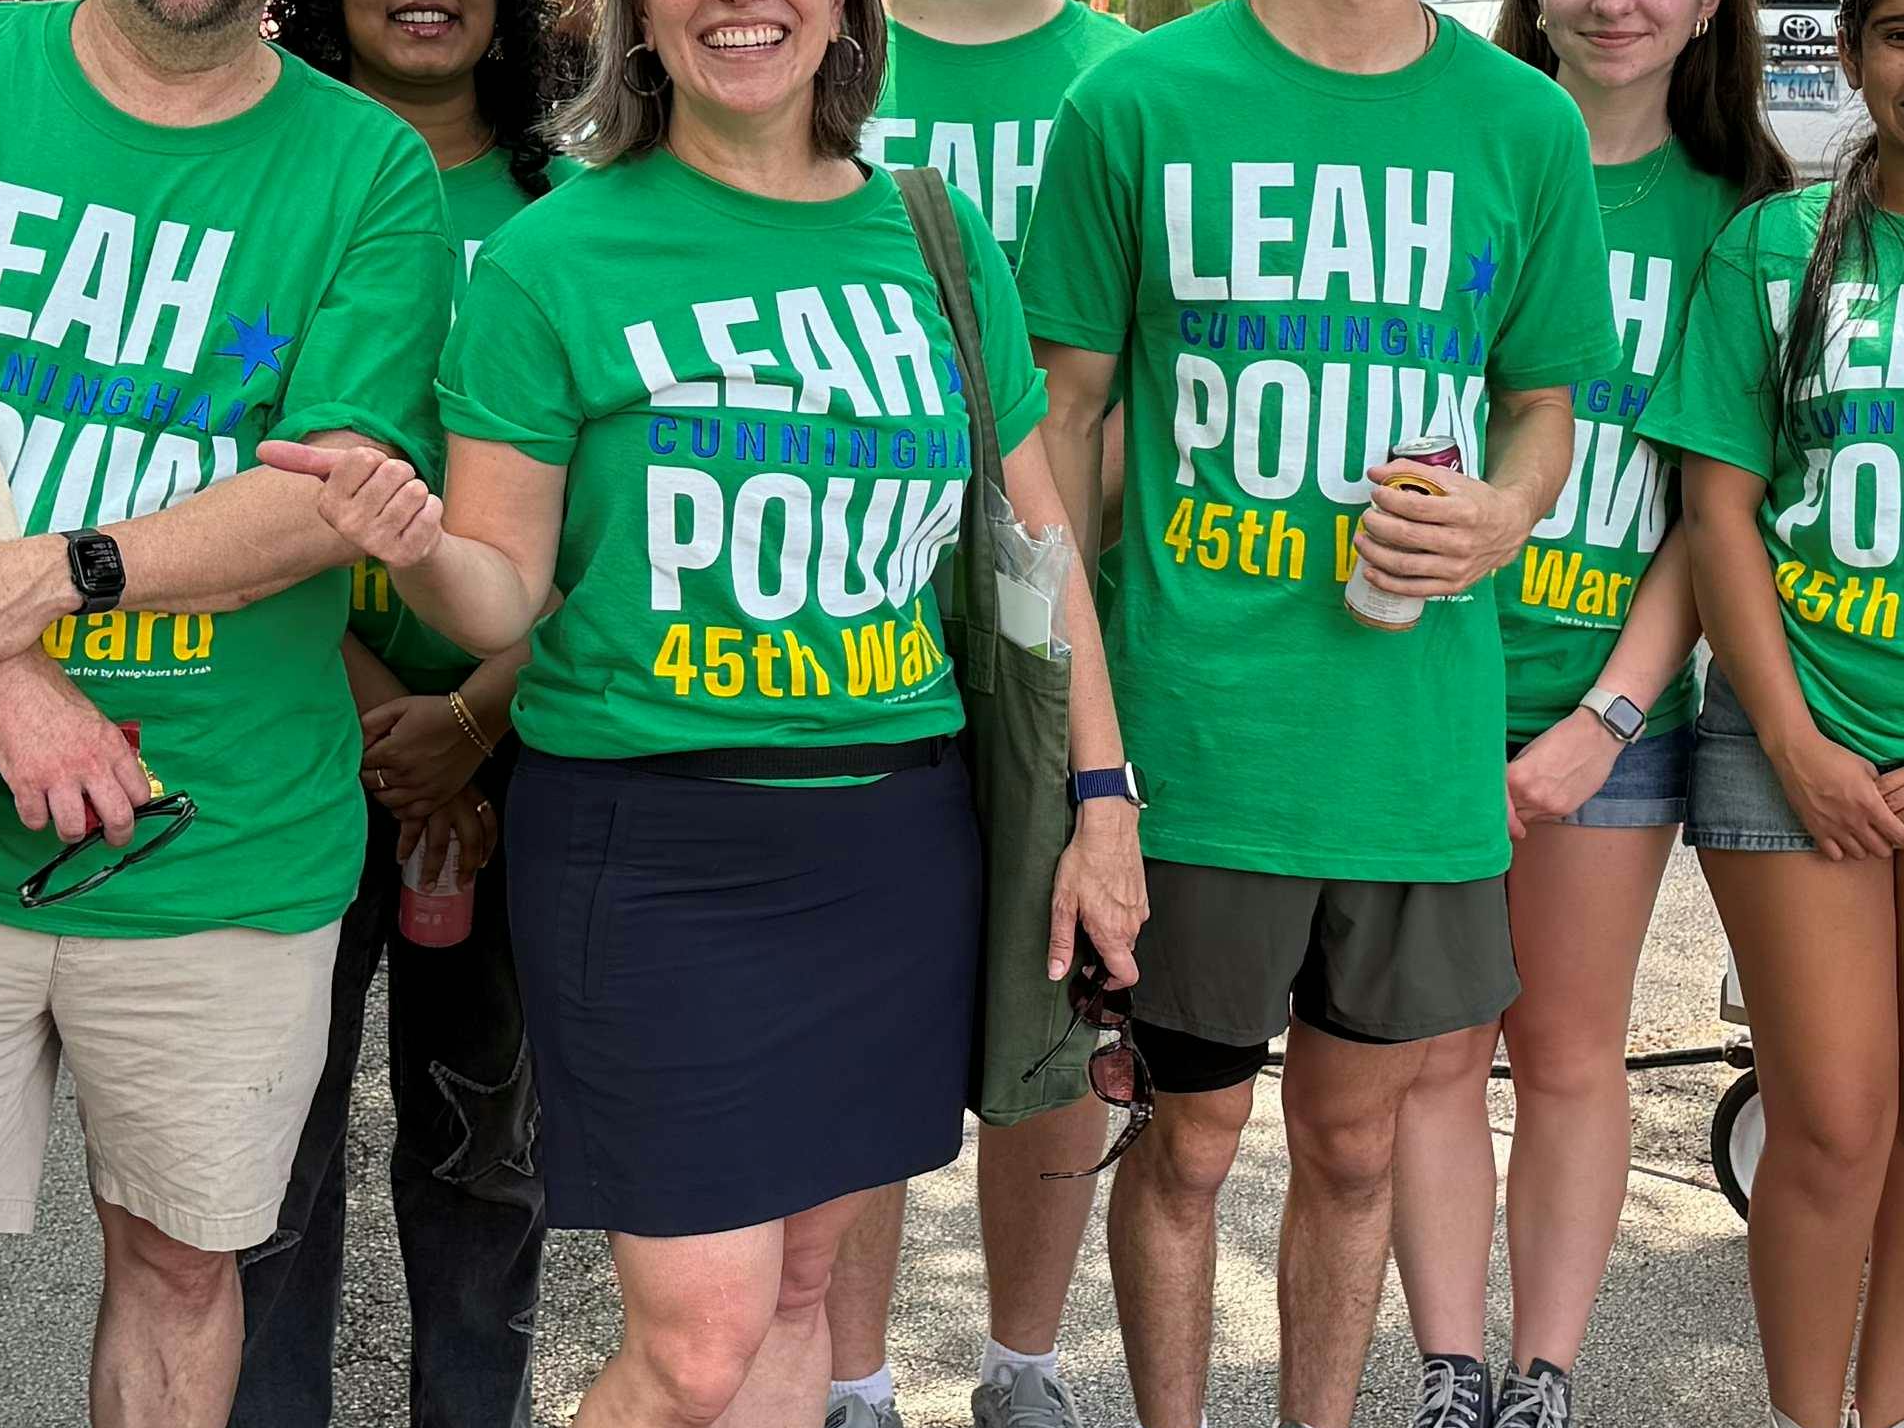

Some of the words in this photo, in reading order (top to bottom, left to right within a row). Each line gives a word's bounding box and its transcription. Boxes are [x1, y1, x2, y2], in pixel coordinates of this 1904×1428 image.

[860, 117, 1055, 241] EAH
[1164, 162, 1454, 311] LEAH
[623, 283, 946, 417] LEAH
[648, 417, 970, 470] CUNNINGHA
[1164, 498, 1305, 581] 45th
[1521, 545, 1632, 618] War
[65, 667, 81, 677] aid
[654, 624, 831, 698] 45th
